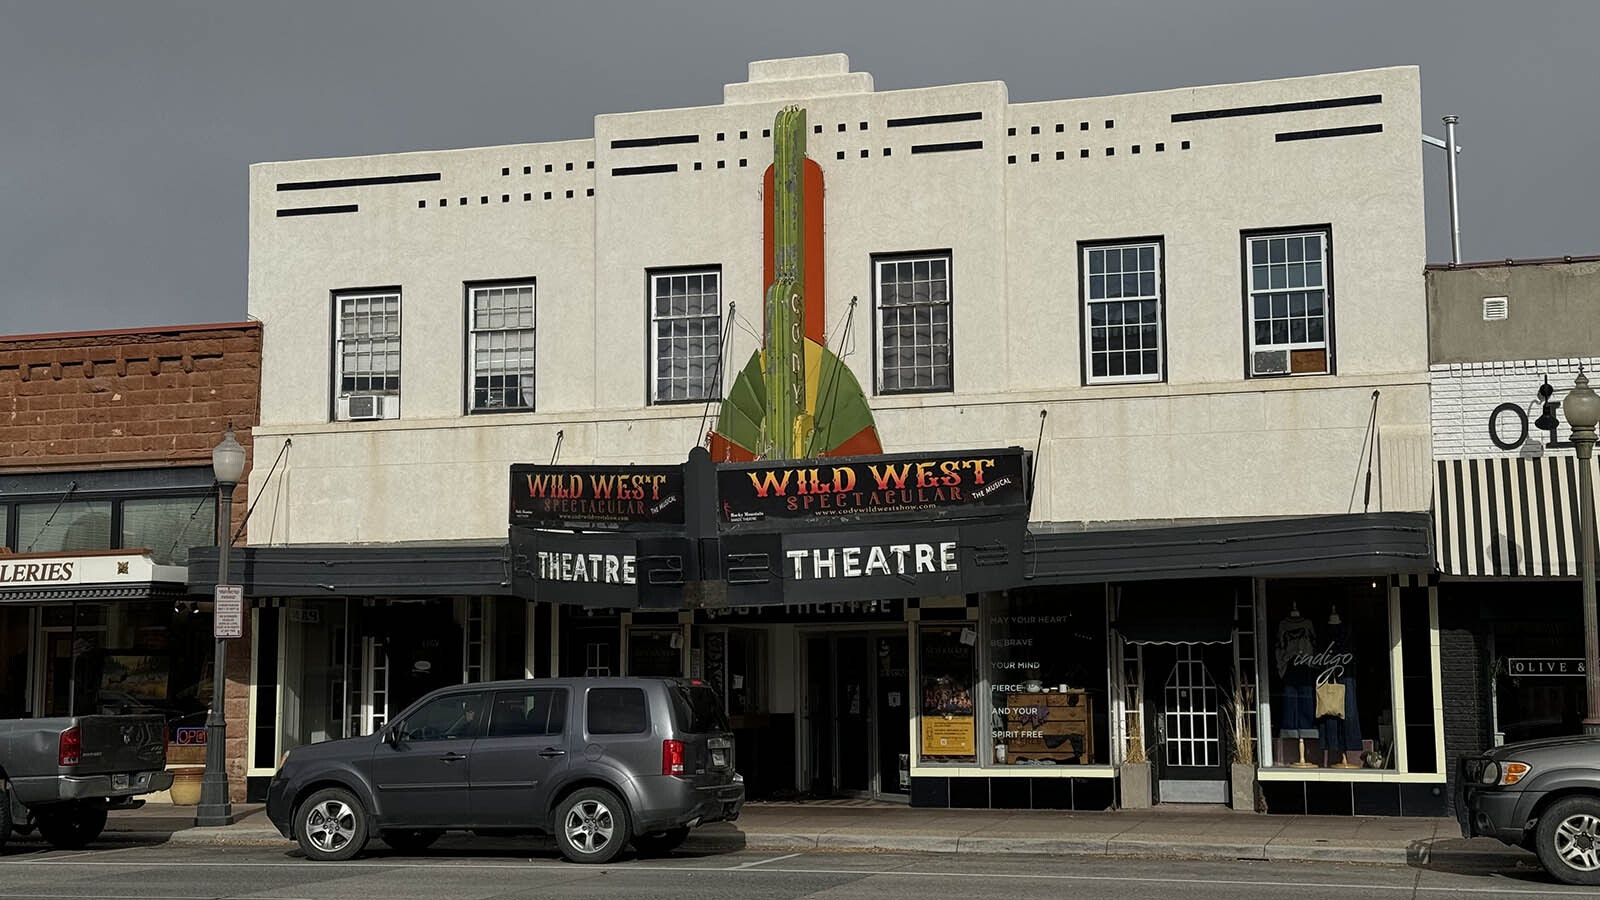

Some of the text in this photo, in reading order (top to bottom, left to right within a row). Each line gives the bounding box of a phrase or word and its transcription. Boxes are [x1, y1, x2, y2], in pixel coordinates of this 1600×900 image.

[791, 293, 802, 404] CODY
[1489, 402, 1600, 450] OL
[526, 474, 667, 500] WILD WEST
[747, 458, 996, 497] WILD WEST
[971, 477, 1012, 499] THE MUSICAL
[544, 499, 645, 515] SPECTACULAR
[786, 487, 964, 511] SPECTACULAR
[815, 503, 936, 516] www.codywildwestshow.com
[538, 551, 636, 584] THEATRE
[786, 542, 958, 580] THEATRE
[0, 562, 74, 582] LERIES
[991, 616, 1067, 624] MAY YOUR HEART
[991, 638, 1033, 647] BE BRAVE
[991, 661, 1040, 670] YOUR MIND
[1293, 641, 1353, 686] indigo
[1516, 662, 1585, 672] OLIVE &
[991, 684, 1022, 692] FIERCE
[991, 707, 1038, 715] AND YOUR
[991, 730, 1043, 738] SPIRIT FREE
